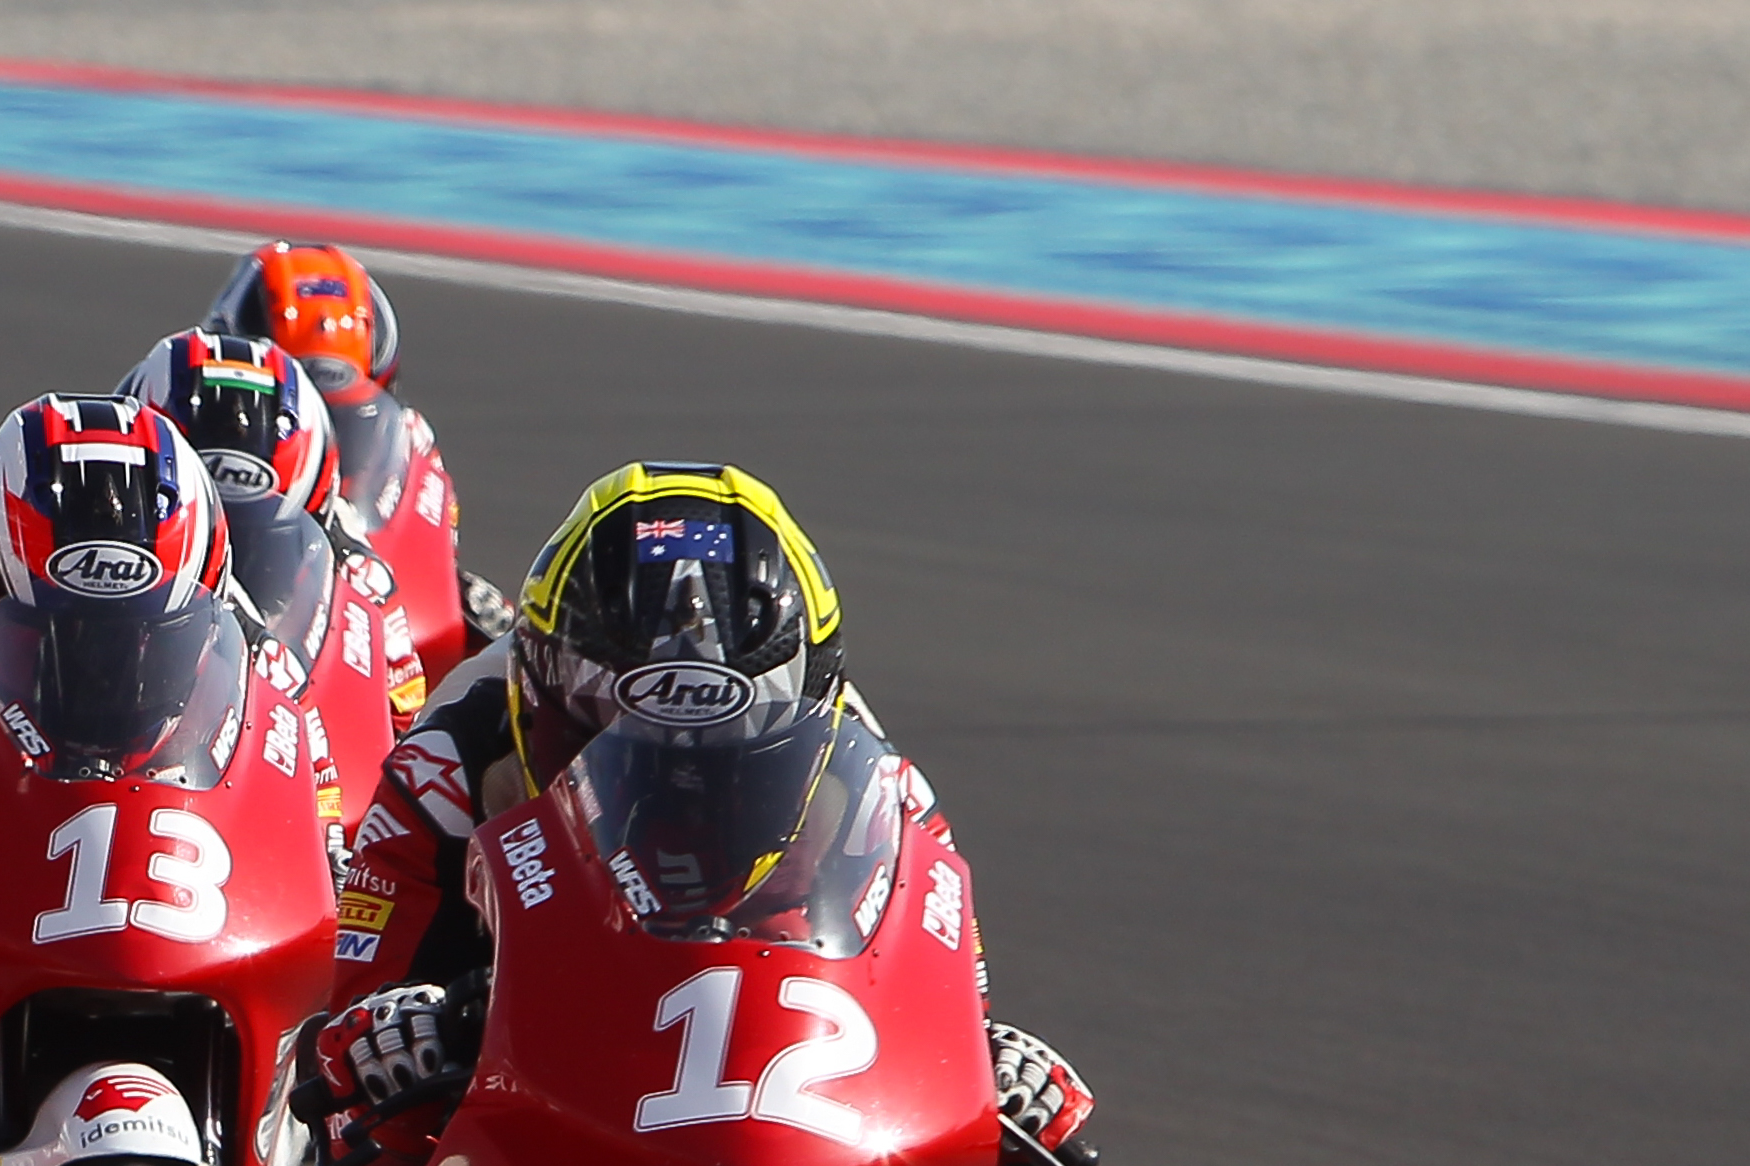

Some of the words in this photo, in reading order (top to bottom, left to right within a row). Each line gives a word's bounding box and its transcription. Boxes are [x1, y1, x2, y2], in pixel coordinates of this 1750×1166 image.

[57, 549, 149, 581] Arai
[628, 671, 738, 706] Arai
[2, 703, 51, 756] WRS
[265, 704, 299, 761] Beta
[33, 804, 232, 944] 13
[505, 836, 556, 910] Beta
[924, 860, 963, 929] Beta
[634, 967, 878, 1142] 12
[79, 1116, 189, 1149] idemitsu
